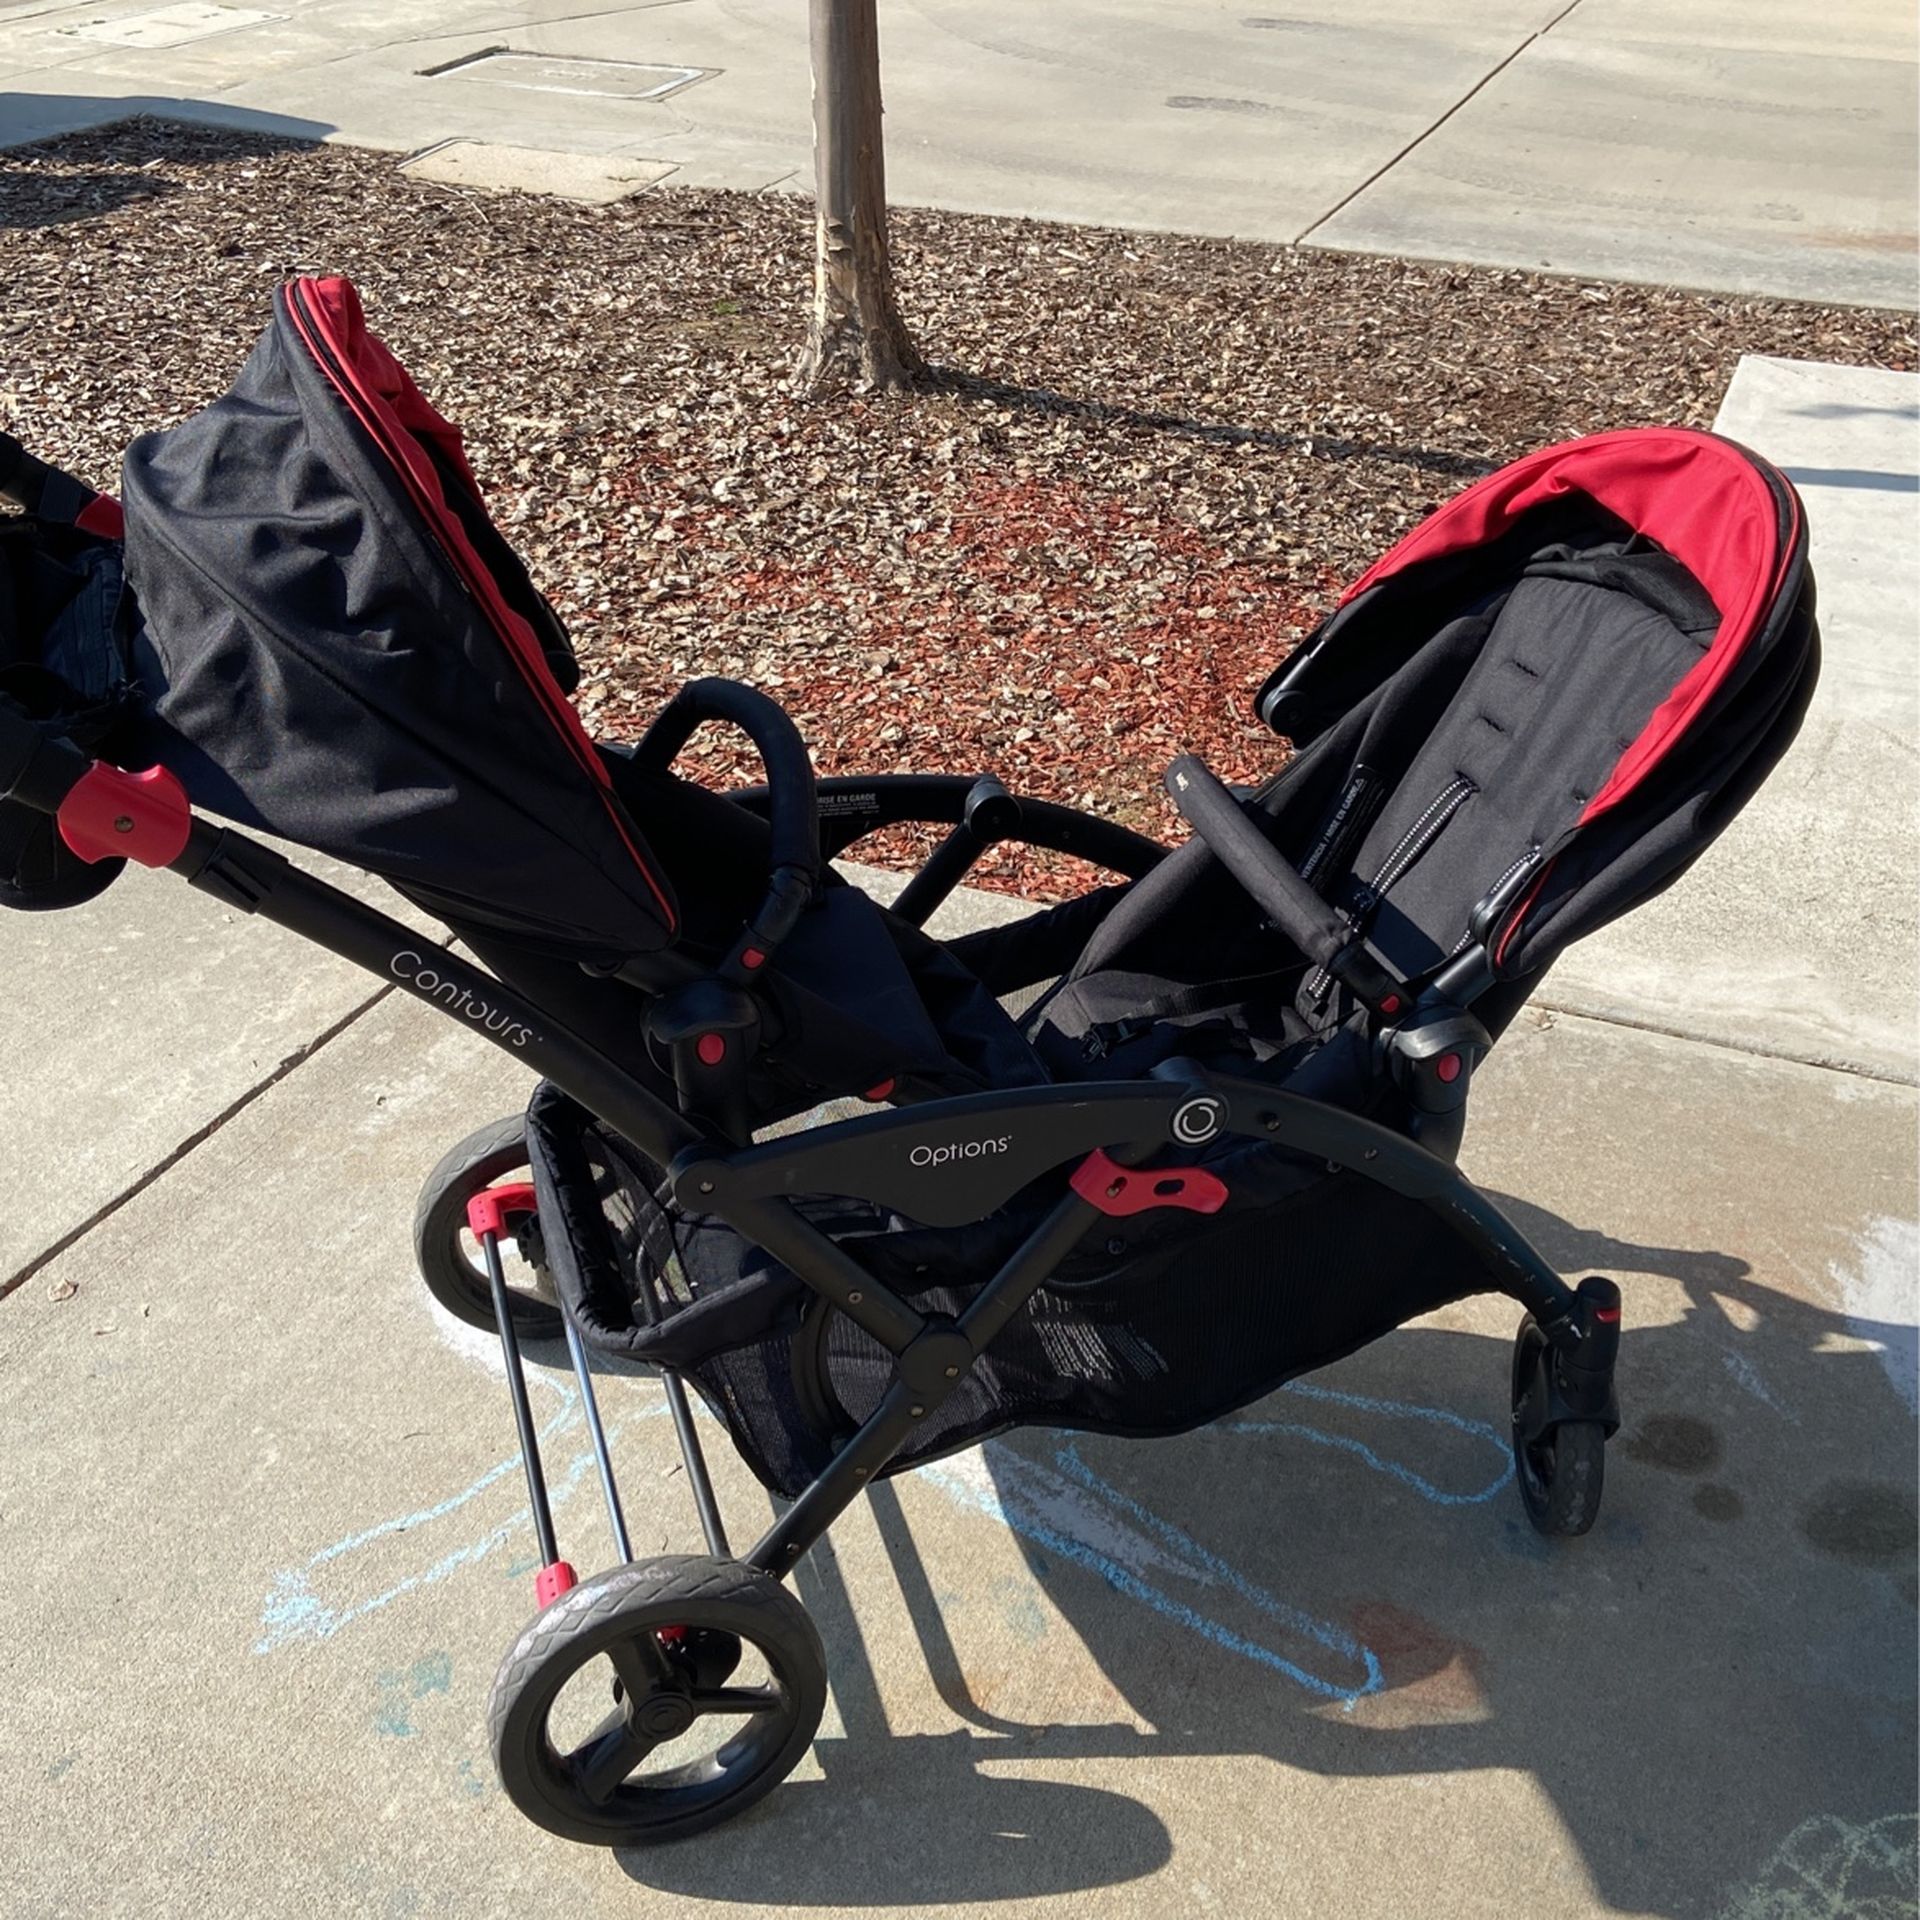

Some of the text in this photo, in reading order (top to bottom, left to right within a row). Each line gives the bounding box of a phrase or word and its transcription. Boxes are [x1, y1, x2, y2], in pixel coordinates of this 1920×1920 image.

[849, 793, 876, 802] GARDE
[390, 951, 534, 1047] Contours
[909, 1136, 1010, 1166] Options
